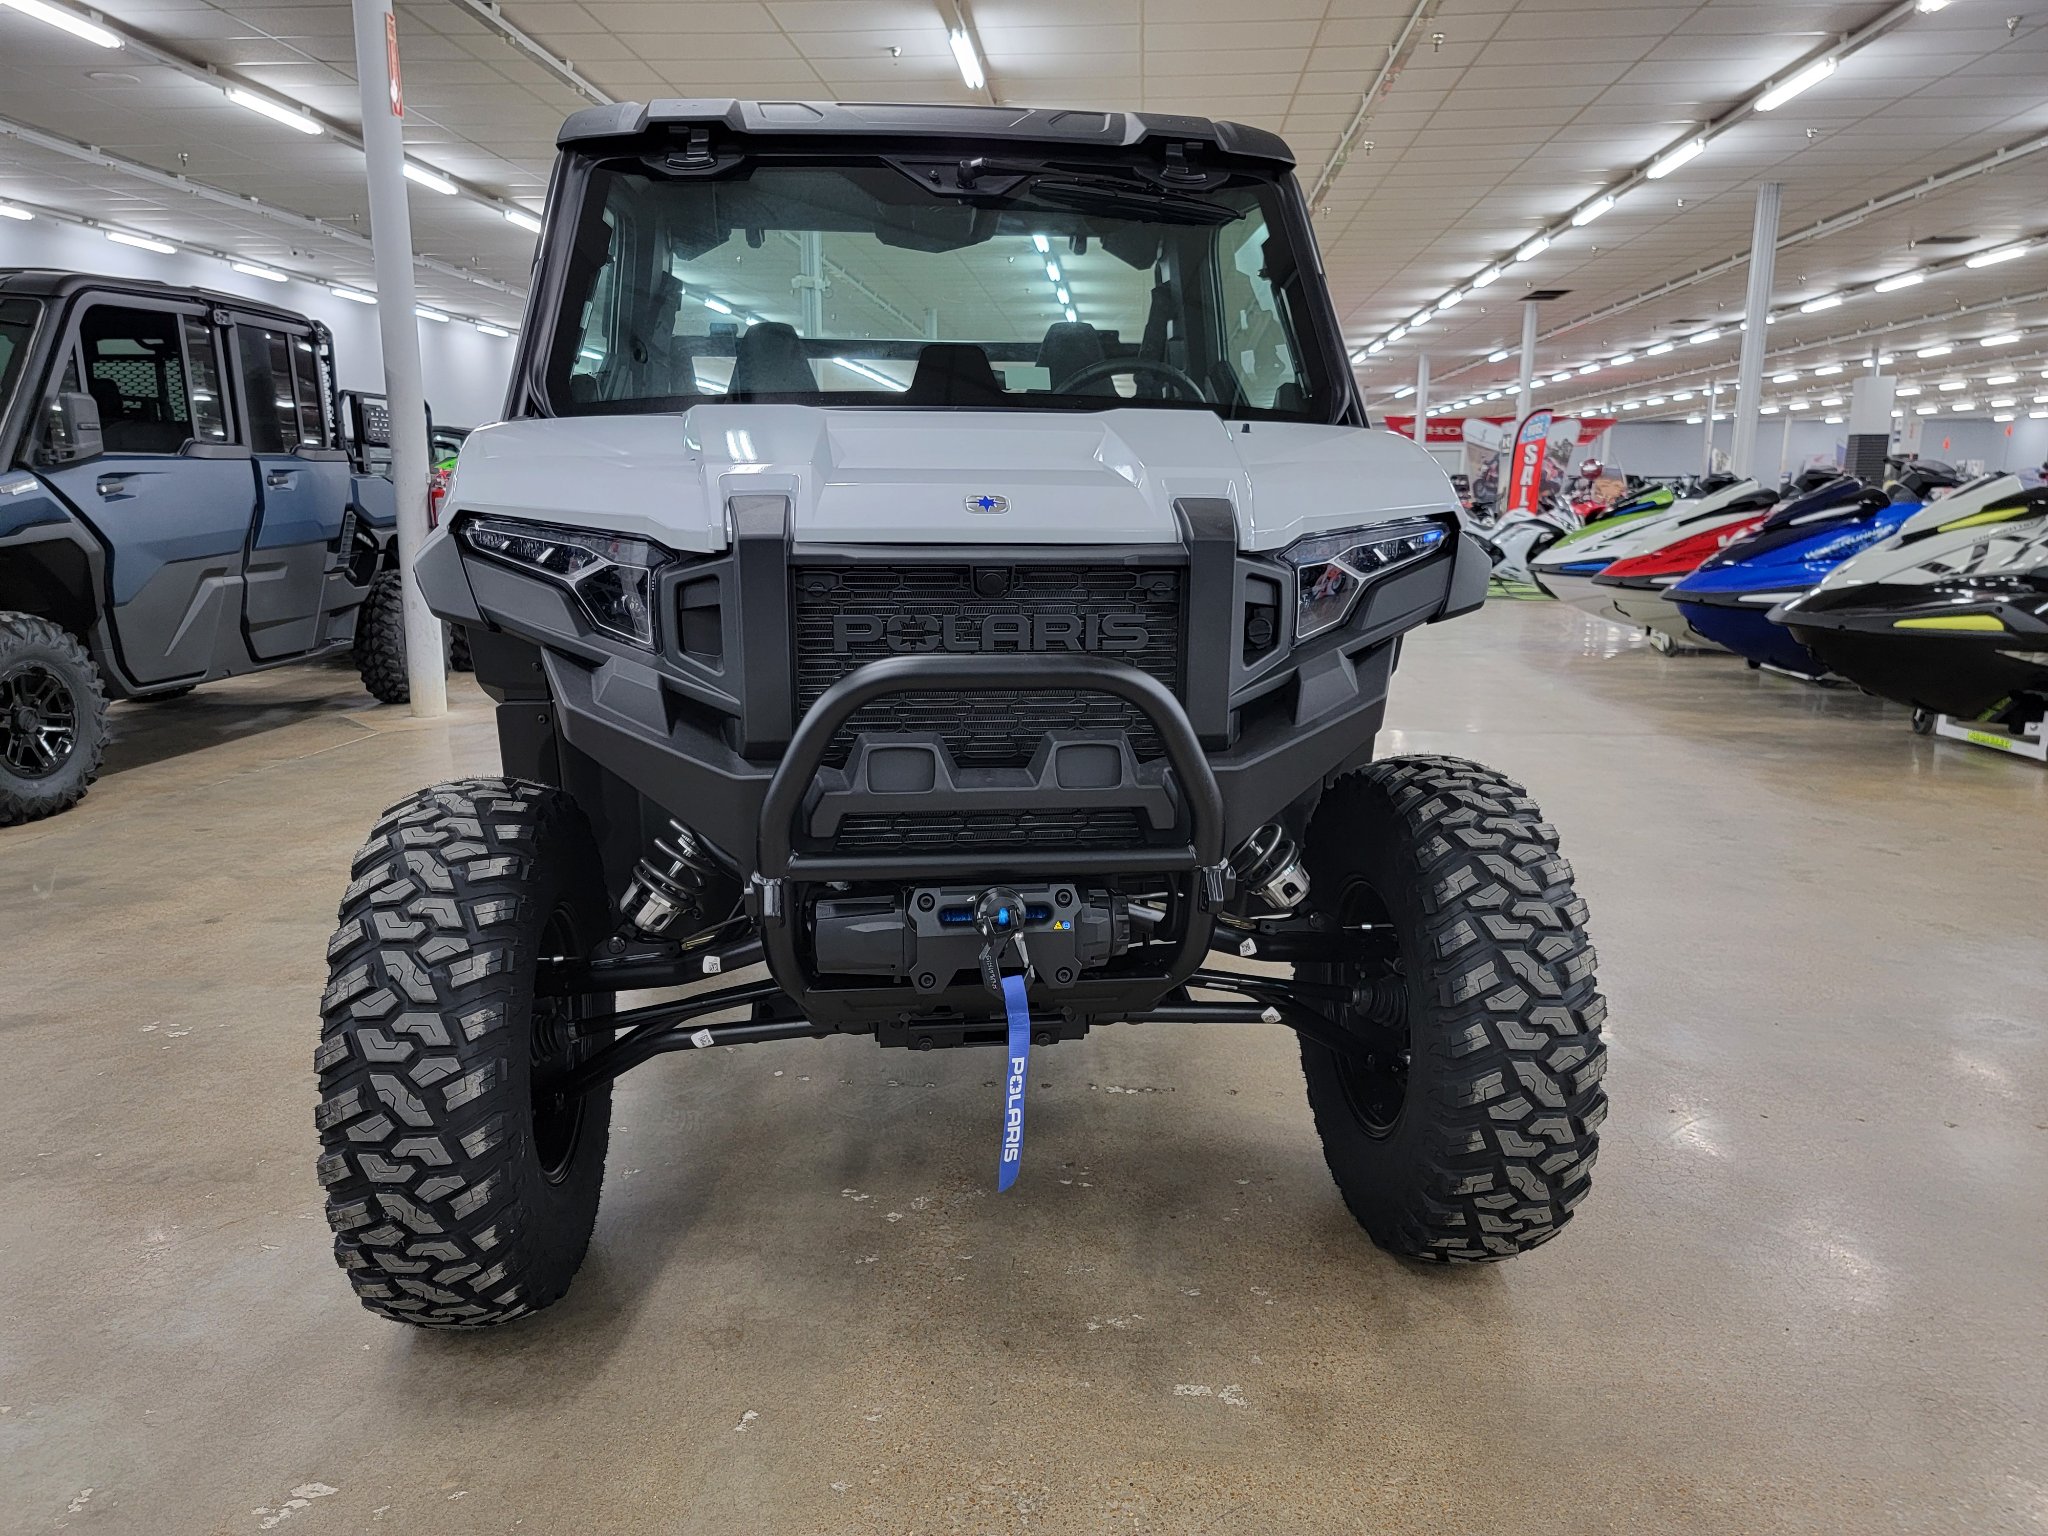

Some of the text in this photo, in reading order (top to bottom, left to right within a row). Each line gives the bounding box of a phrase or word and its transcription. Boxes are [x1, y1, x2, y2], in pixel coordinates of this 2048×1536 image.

[1519, 444, 1538, 507] SAL
[833, 614, 1149, 650] POLARIS
[1003, 1056, 1025, 1163] POLARIS
